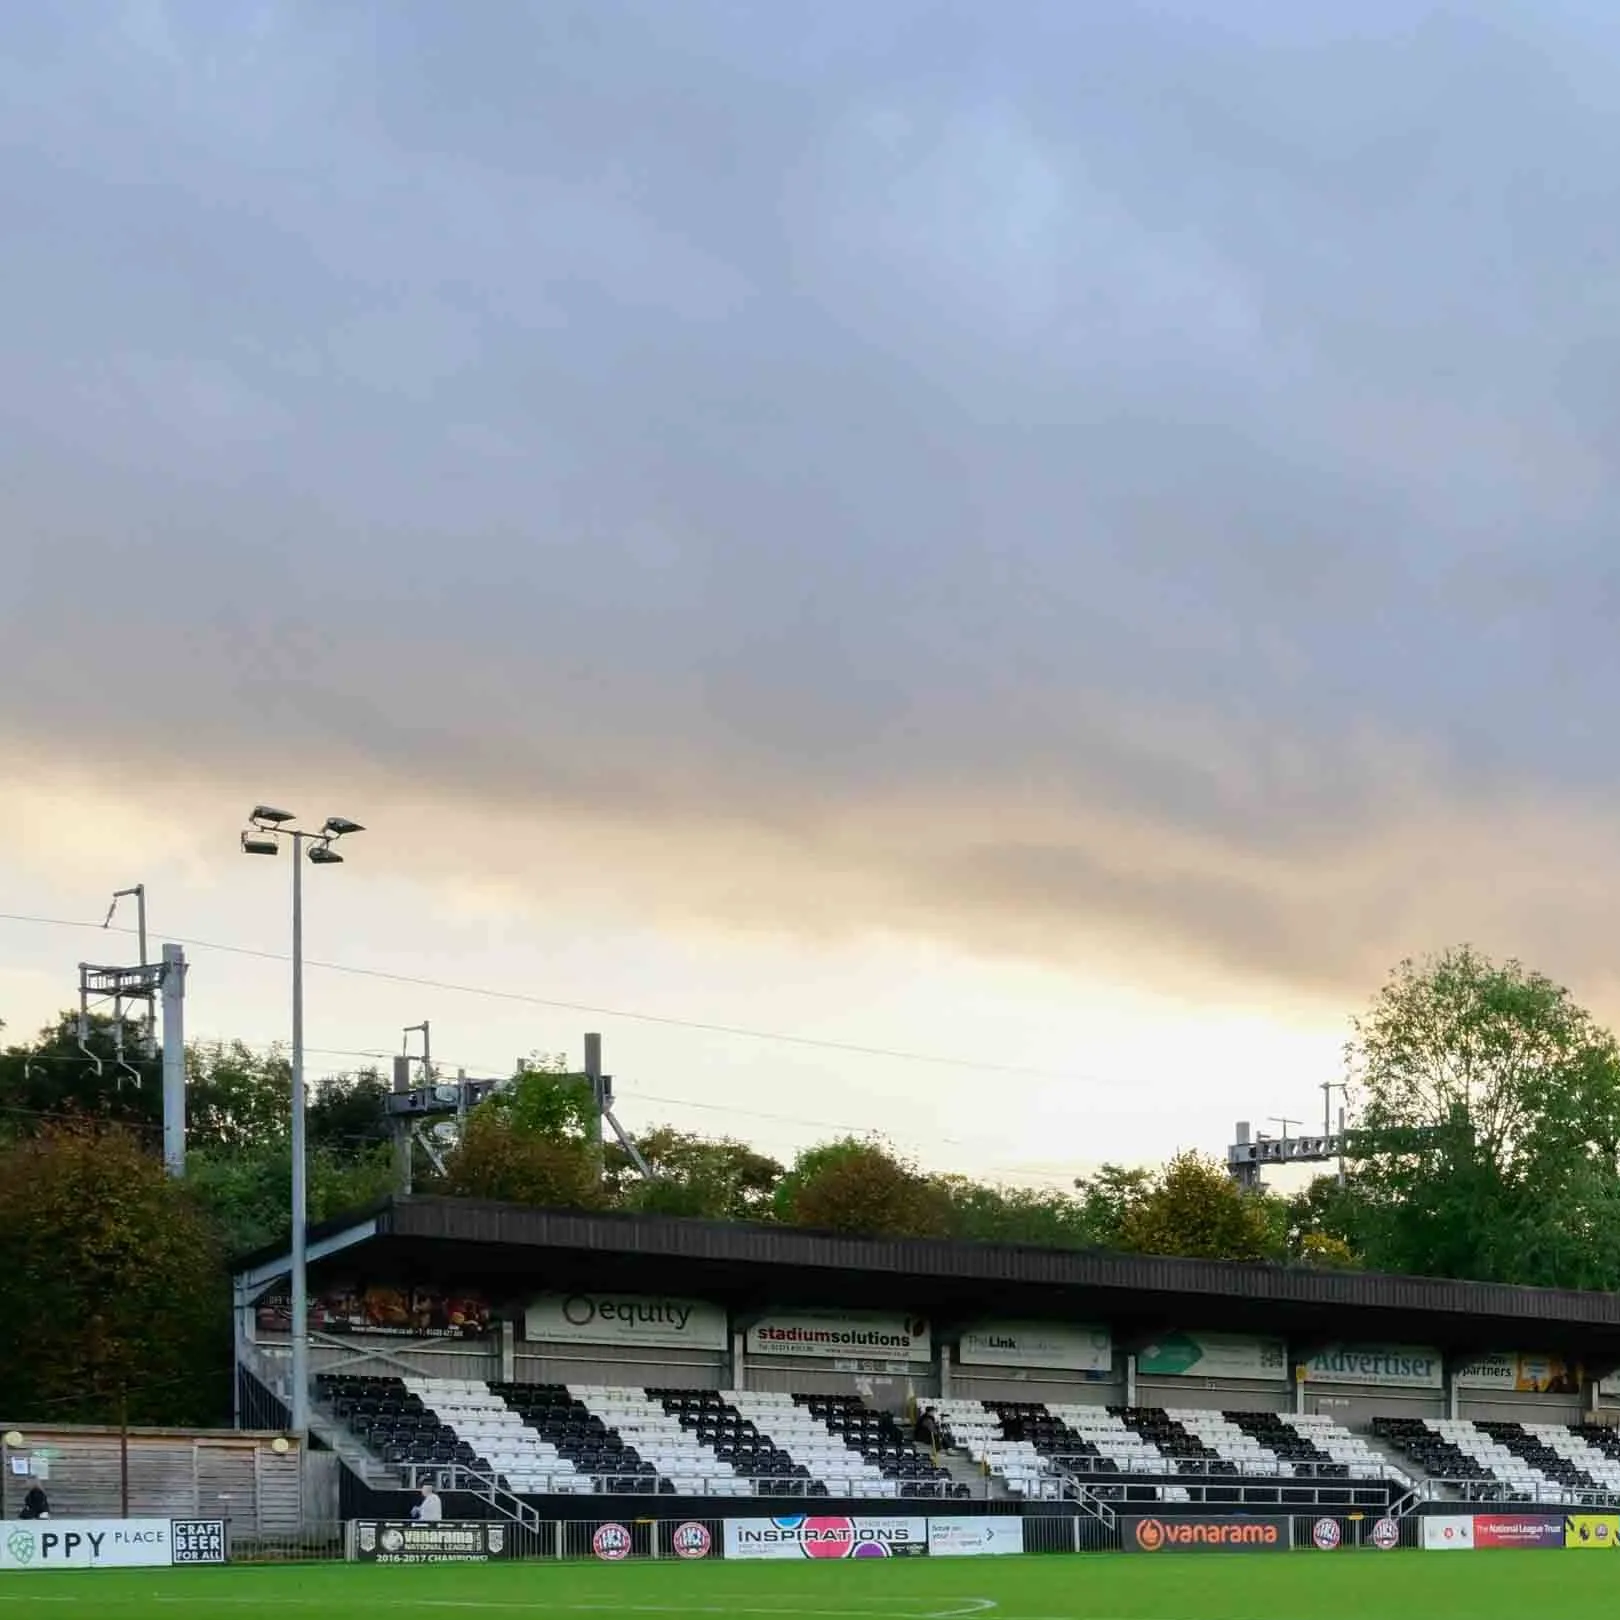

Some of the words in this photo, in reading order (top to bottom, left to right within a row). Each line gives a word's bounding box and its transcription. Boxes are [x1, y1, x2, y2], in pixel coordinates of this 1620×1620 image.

[600, 1301, 691, 1329] equity
[758, 1327, 910, 1347] stadiumsolutions
[990, 1336, 1015, 1348] Link
[1313, 1352, 1435, 1377] Advertiser
[1462, 1365, 1511, 1378] partners
[176, 1524, 220, 1536] CRAFT
[1165, 1524, 1278, 1543] vanarama
[1489, 1523, 1518, 1533] National
[1519, 1523, 1543, 1535] League
[114, 1531, 165, 1544] PLACE
[176, 1536, 220, 1550] BEER
[176, 1551, 198, 1560] FOR
[200, 1551, 220, 1560] ALL
[376, 1554, 426, 1563] 2016-2017
